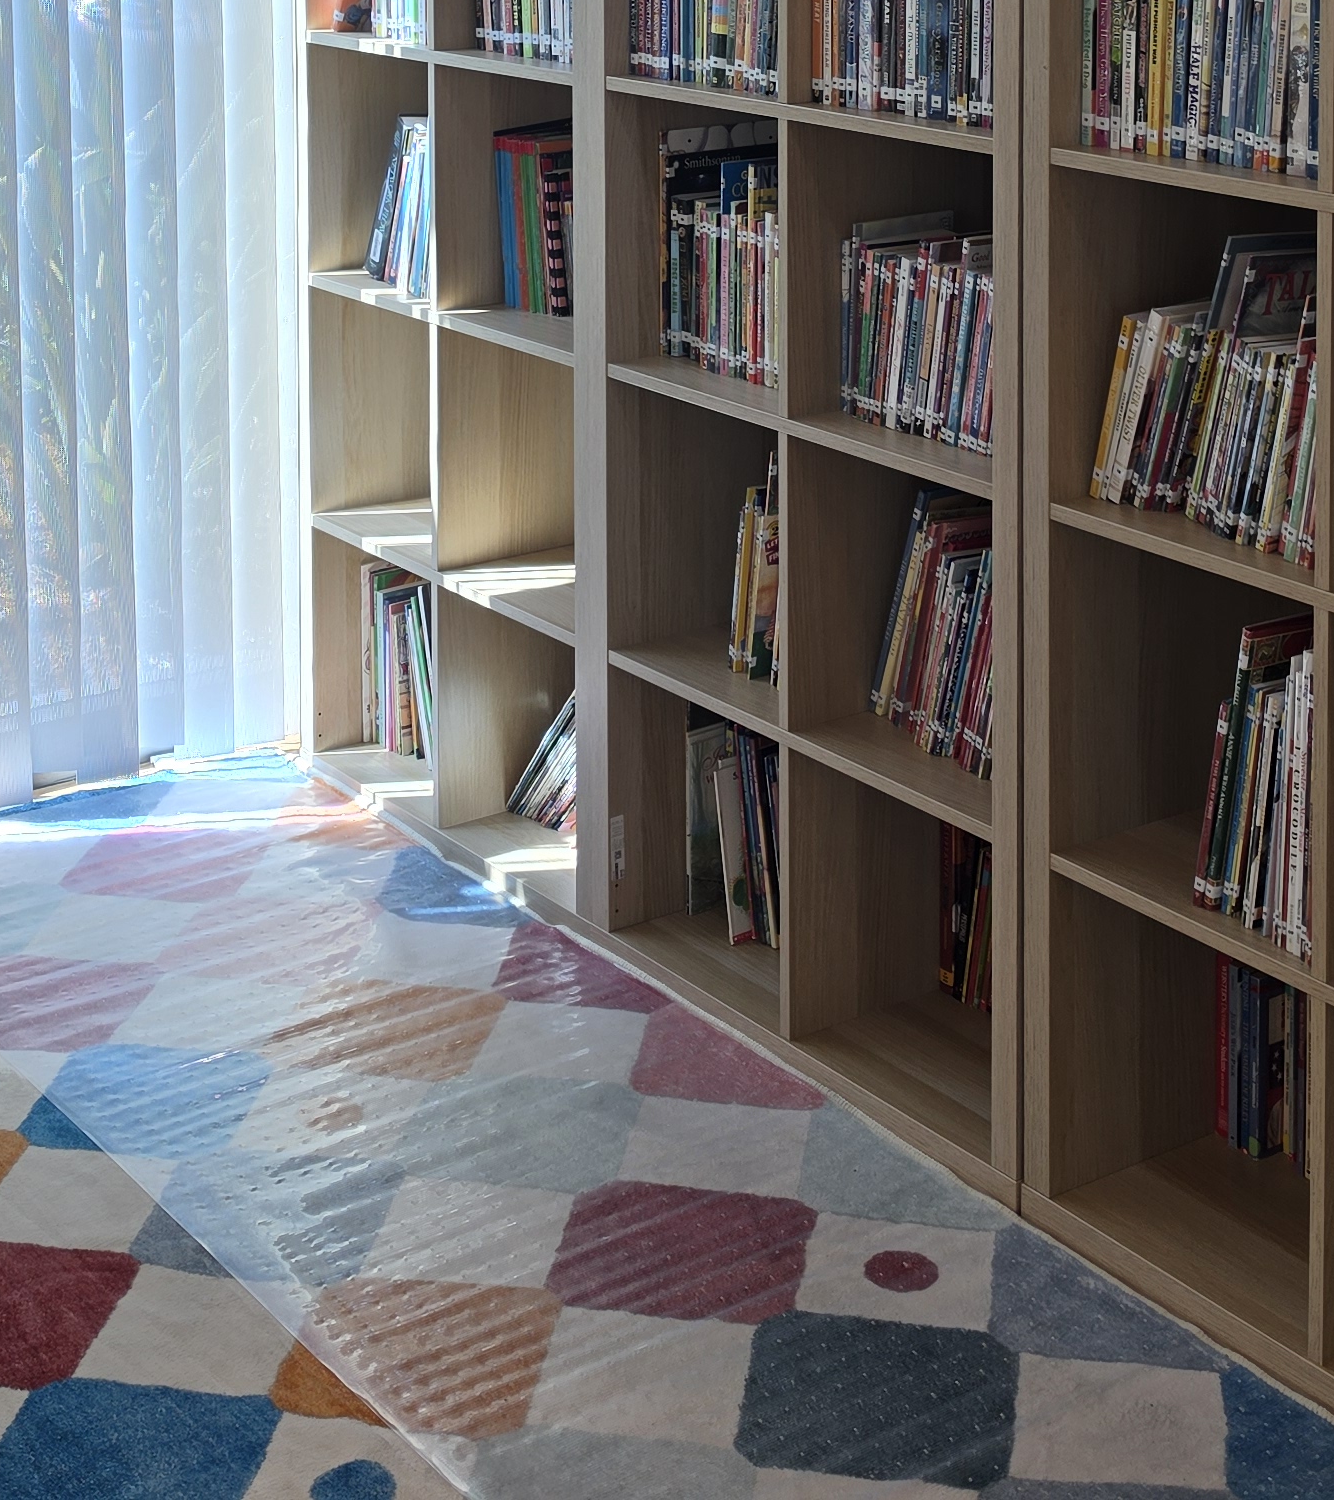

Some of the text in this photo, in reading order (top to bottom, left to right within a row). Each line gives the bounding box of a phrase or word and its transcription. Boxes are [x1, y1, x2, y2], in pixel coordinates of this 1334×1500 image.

[1100, 1, 1109, 26] These
[1188, 45, 1202, 125] HALF MAGIC
[684, 153, 741, 169] Smithsonian
[1121, 365, 1147, 444] OLIVER TWIST
[1290, 769, 1301, 873] CROCODILE
